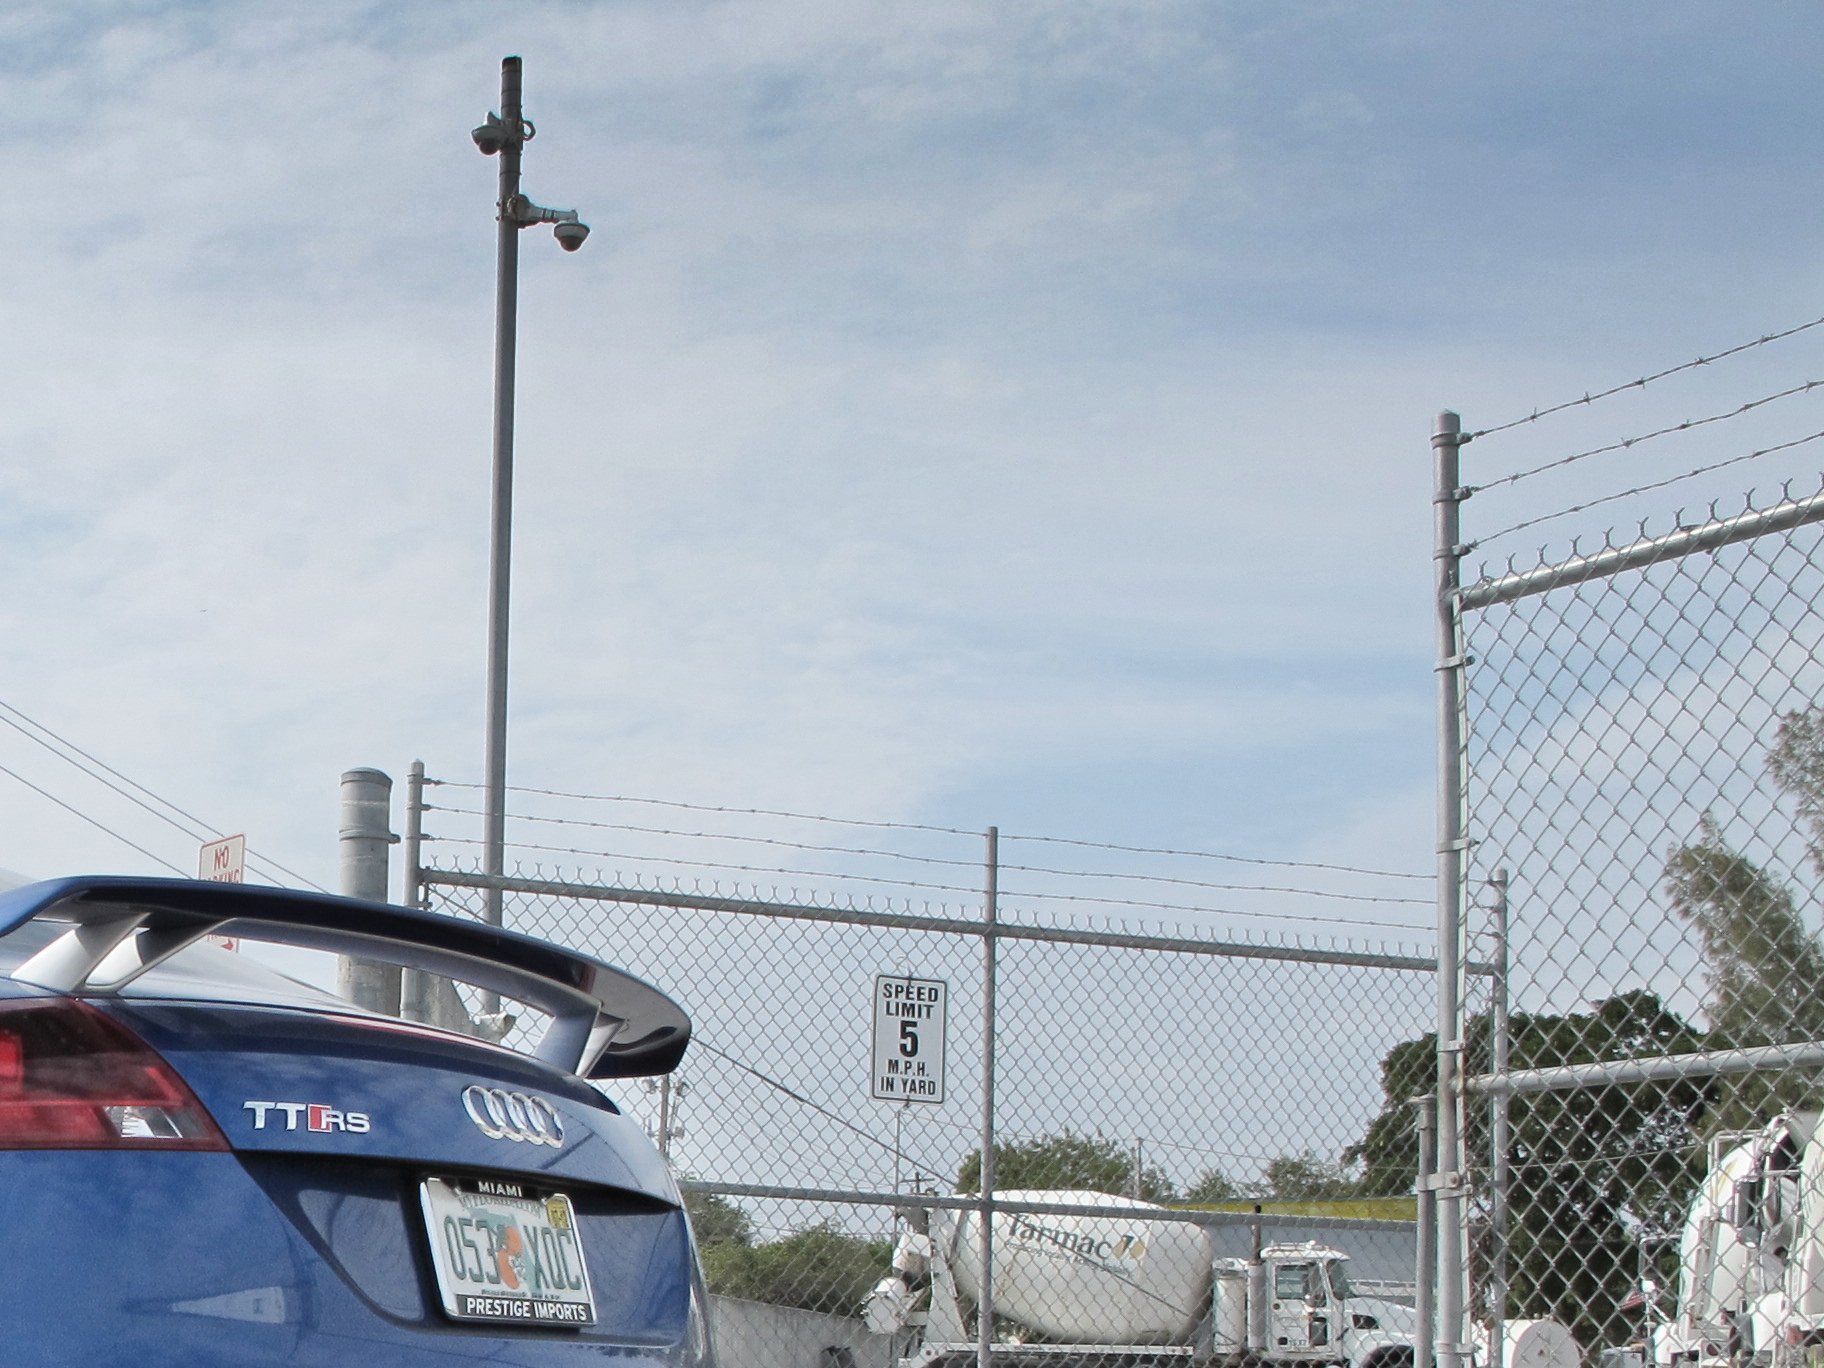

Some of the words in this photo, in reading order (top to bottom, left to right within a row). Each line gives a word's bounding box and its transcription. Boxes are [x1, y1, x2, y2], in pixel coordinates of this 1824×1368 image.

[213, 845, 230, 871] NO
[882, 983, 939, 1003] SPEED
[885, 1001, 934, 1019] LIMIT
[899, 1019, 919, 1058] 5
[887, 1059, 930, 1077] M.P.H.
[880, 1076, 895, 1092] IN
[901, 1078, 936, 1095] YARD
[478, 1181, 523, 1198] MIAMI
[443, 1215, 501, 1285] 053
[466, 1297, 531, 1318] PRESTIGE
[534, 1302, 588, 1322] IMPORTS
